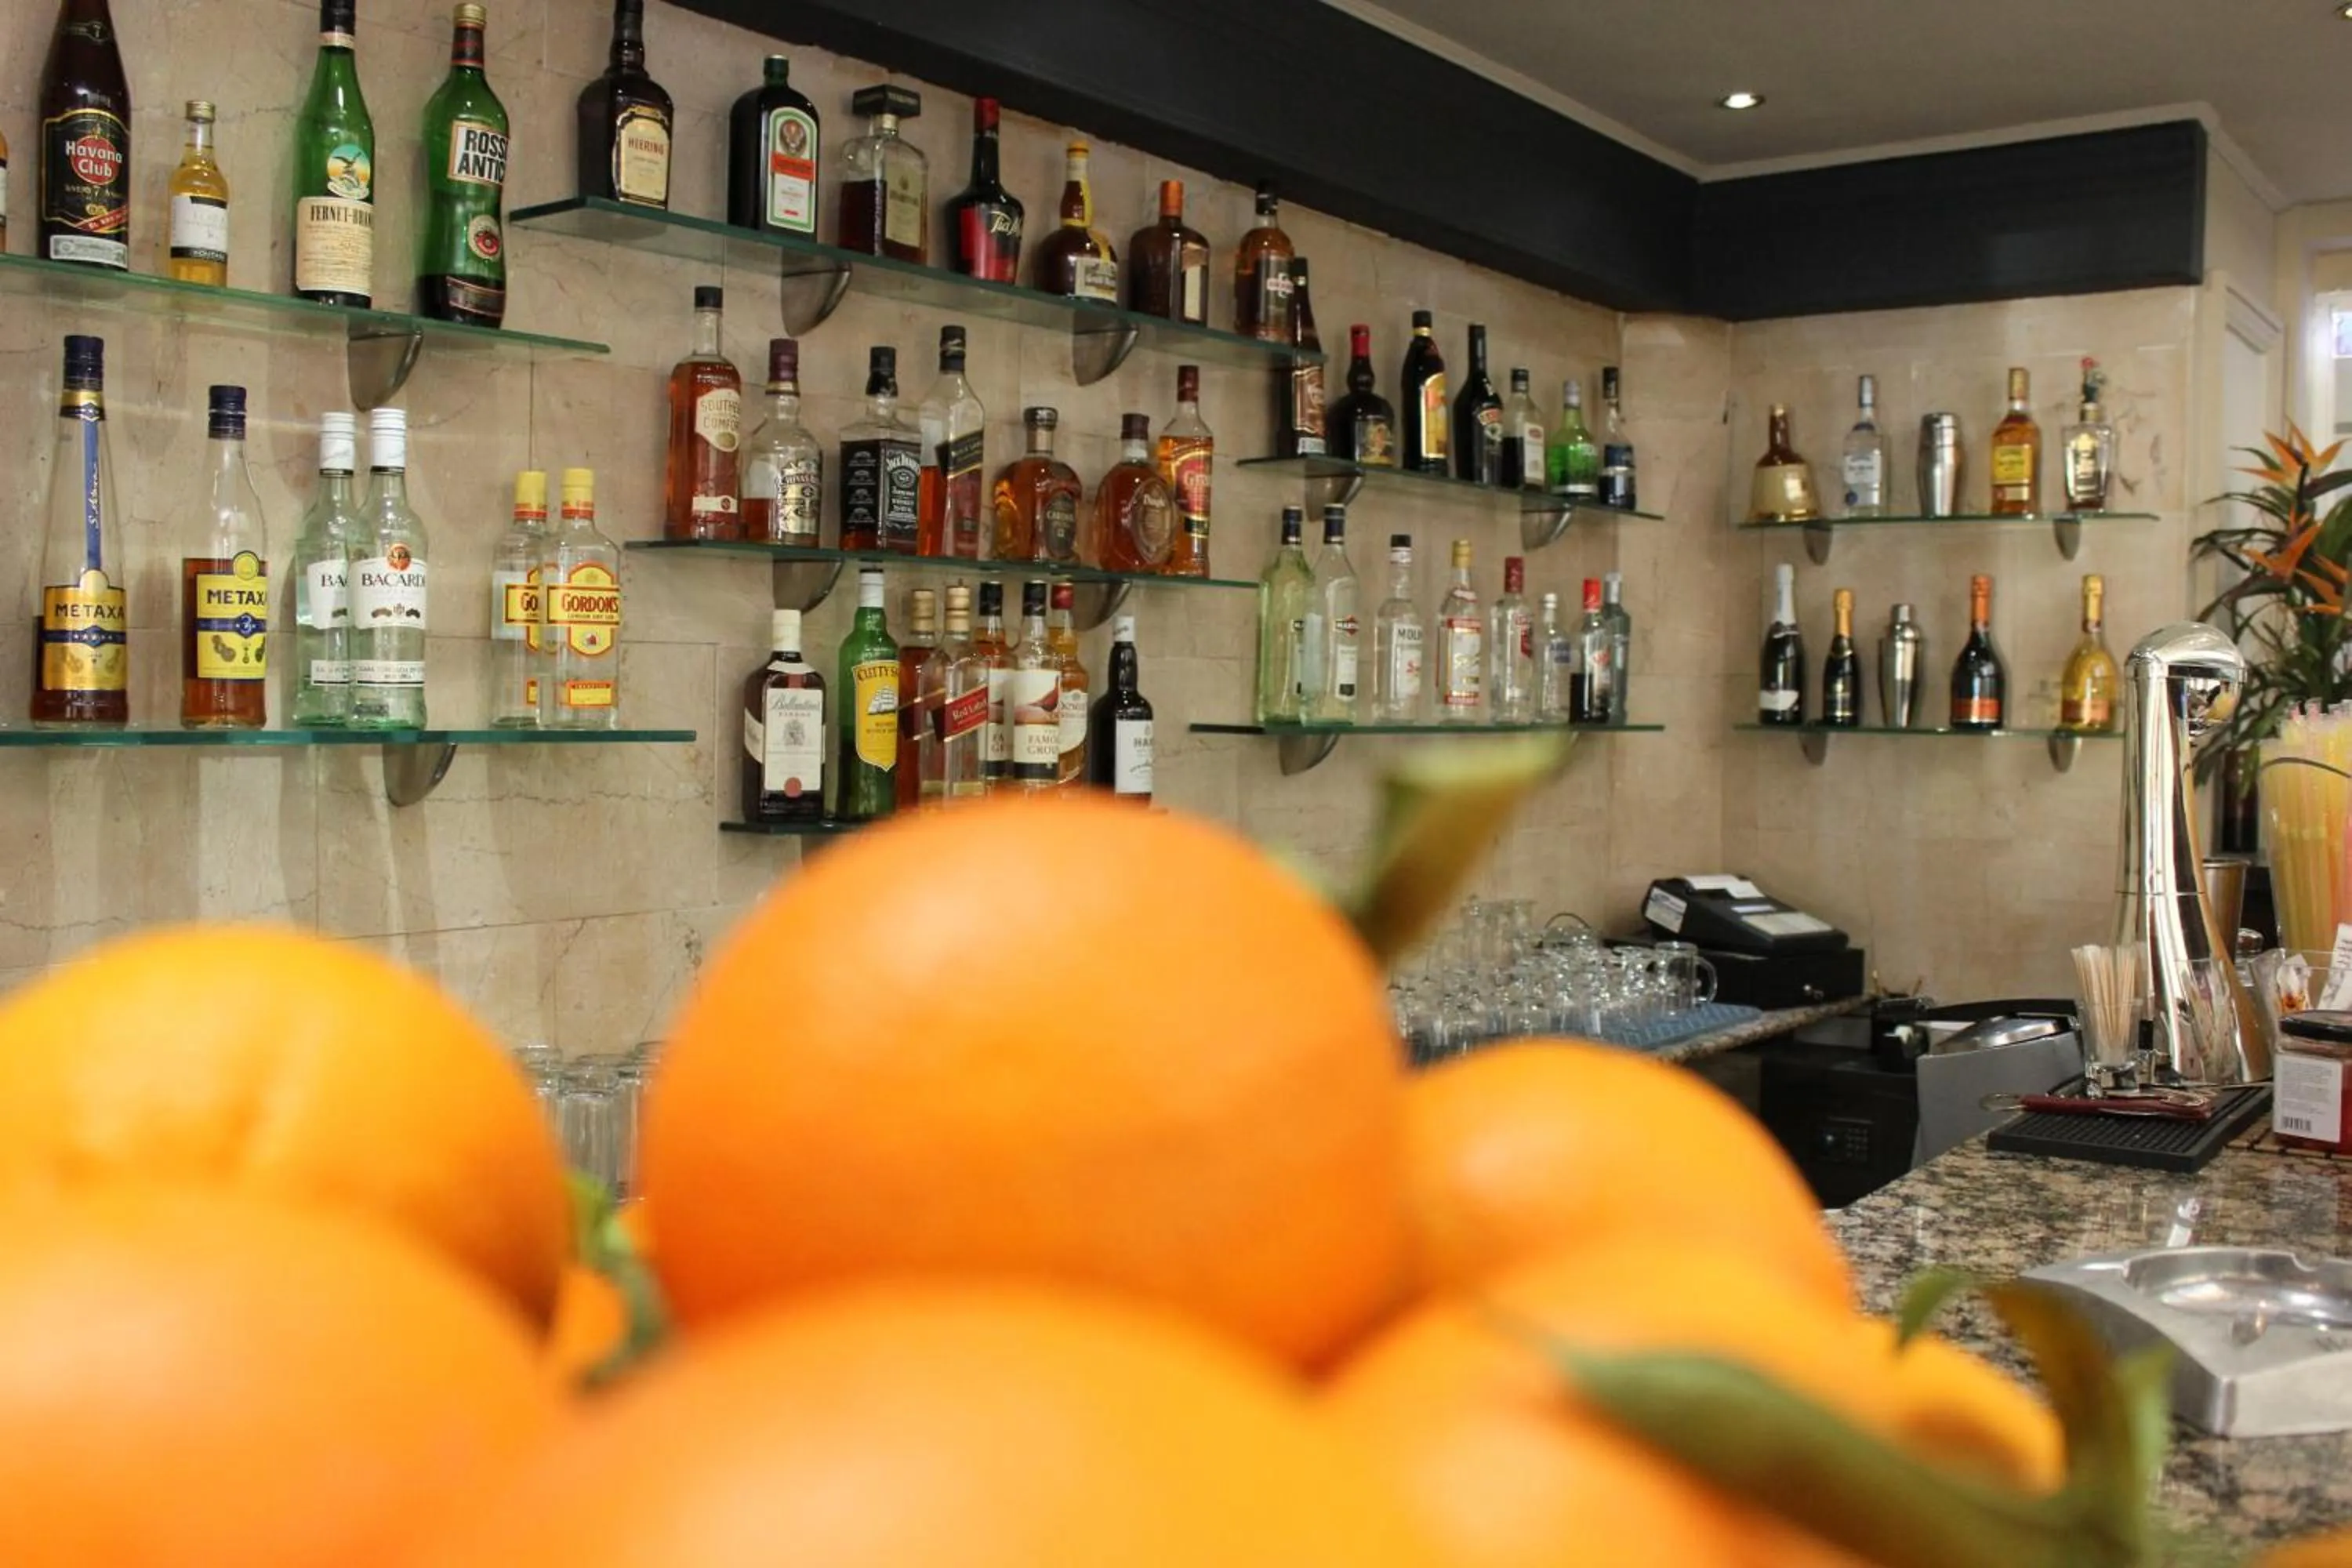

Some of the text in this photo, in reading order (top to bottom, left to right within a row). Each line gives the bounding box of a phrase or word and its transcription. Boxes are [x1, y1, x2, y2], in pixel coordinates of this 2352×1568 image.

[65, 140, 123, 164] Havana
[628, 137, 665, 156] HEERING
[78, 158, 113, 176] Club
[321, 573, 348, 588] BA
[207, 589, 267, 606] METAX
[55, 603, 125, 619] METAXA
